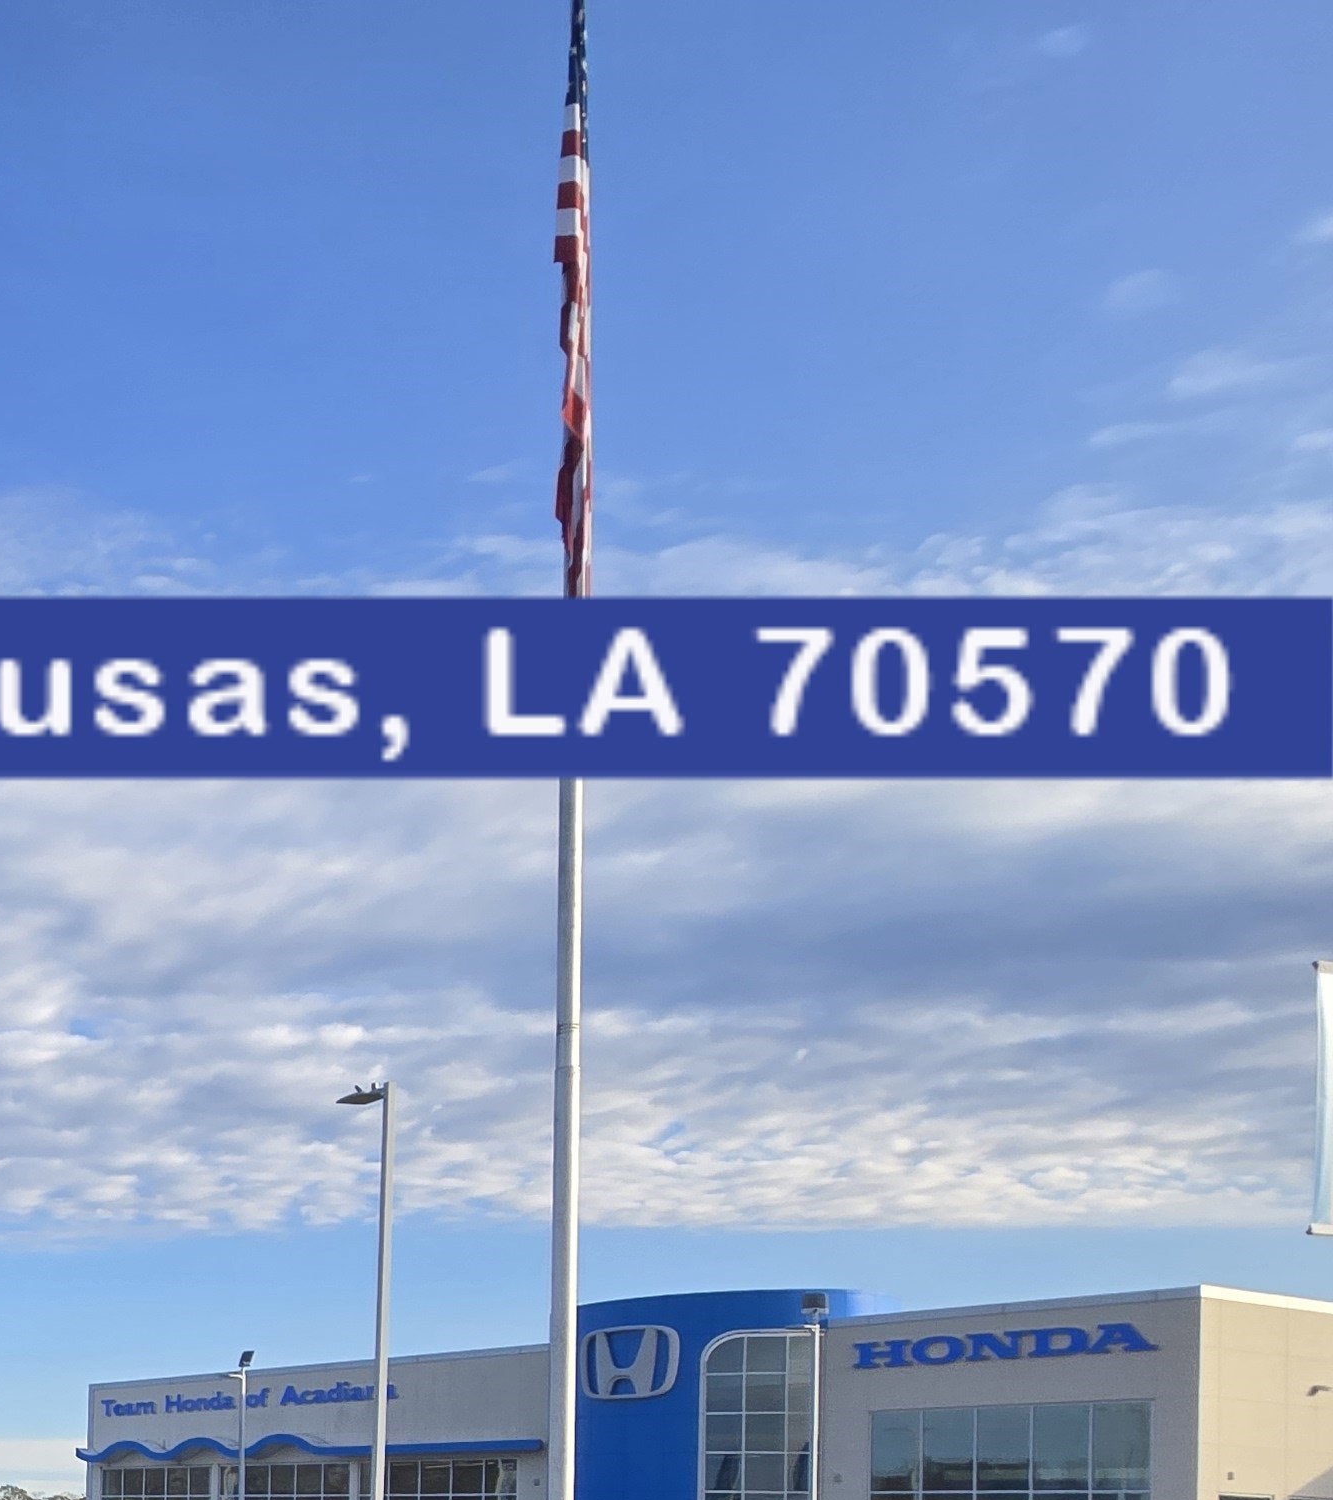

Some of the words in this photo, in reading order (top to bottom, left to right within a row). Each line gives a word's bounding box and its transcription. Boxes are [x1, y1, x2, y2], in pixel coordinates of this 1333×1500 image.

[852, 1322, 1159, 1370] HONDA
[101, 1400, 156, 1417] Team
[164, 1391, 236, 1413] Honda
[245, 1388, 270, 1408] of
